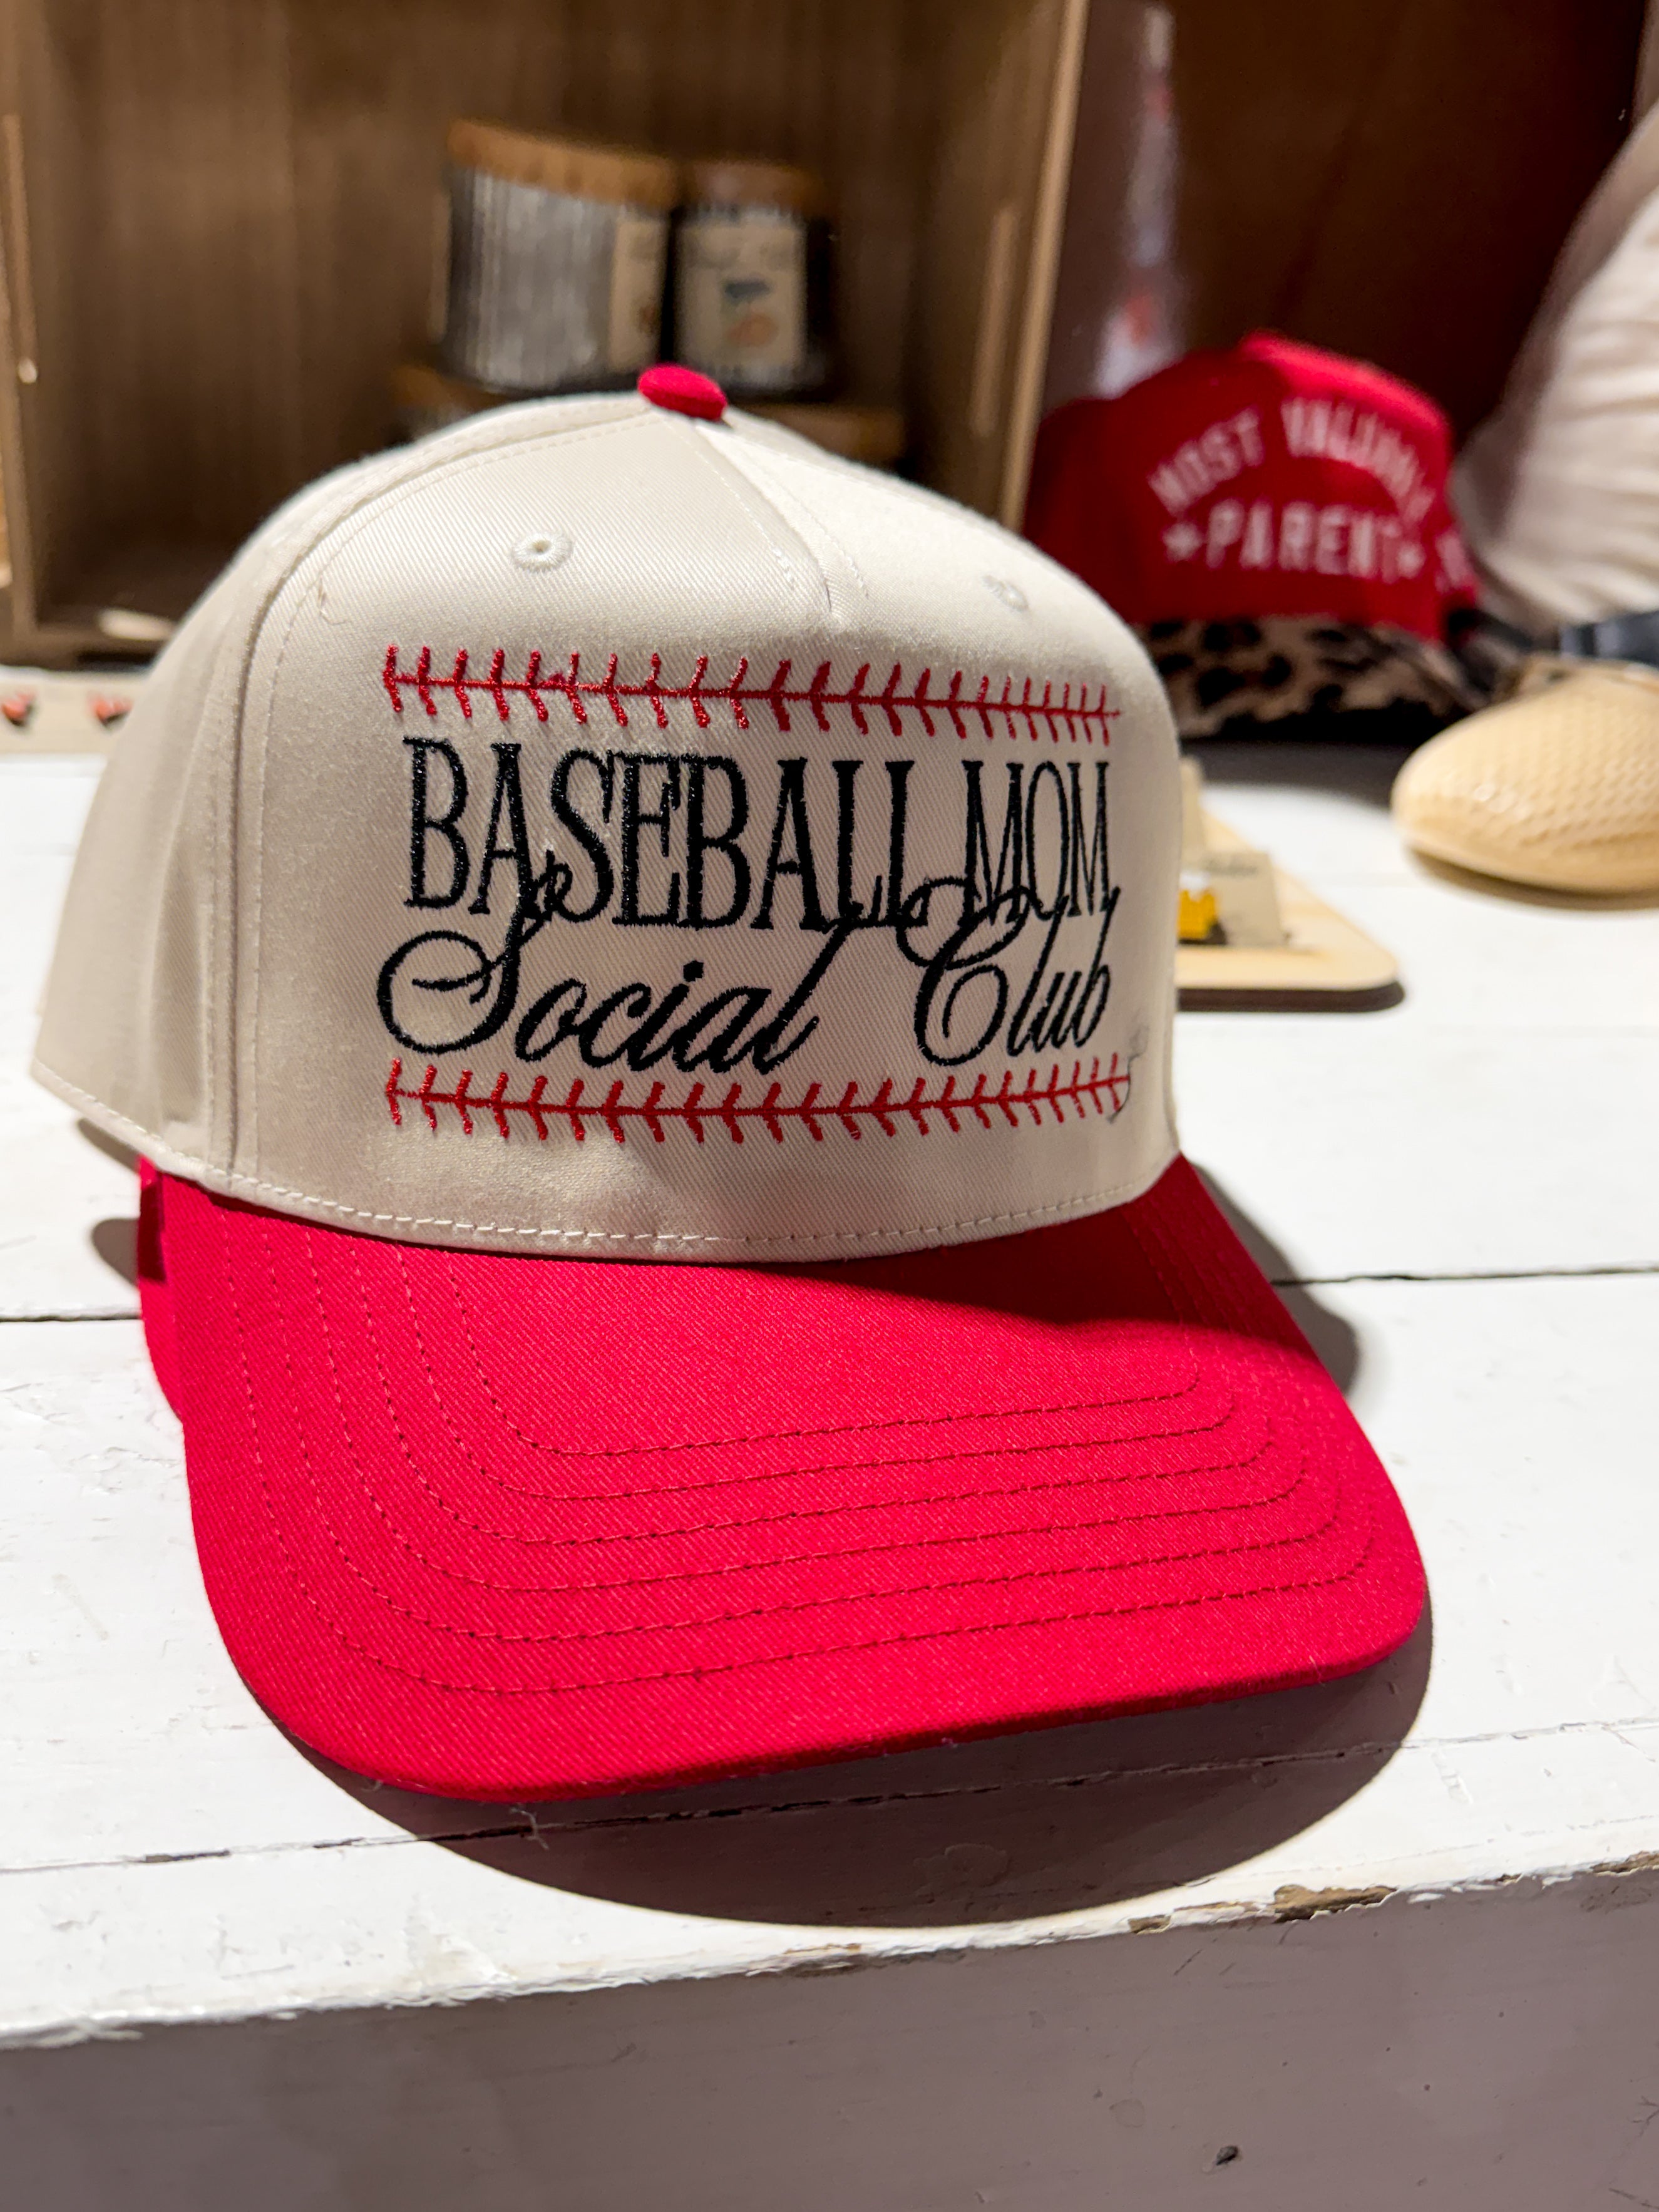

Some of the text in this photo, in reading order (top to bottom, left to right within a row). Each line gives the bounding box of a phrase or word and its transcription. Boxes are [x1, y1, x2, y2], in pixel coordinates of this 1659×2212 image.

[1149, 406, 1263, 516] MOST
[1206, 499, 1399, 584] PARENT
[403, 736, 1111, 932] BASEBALL MOM
[377, 849, 1120, 1074] Social Club
